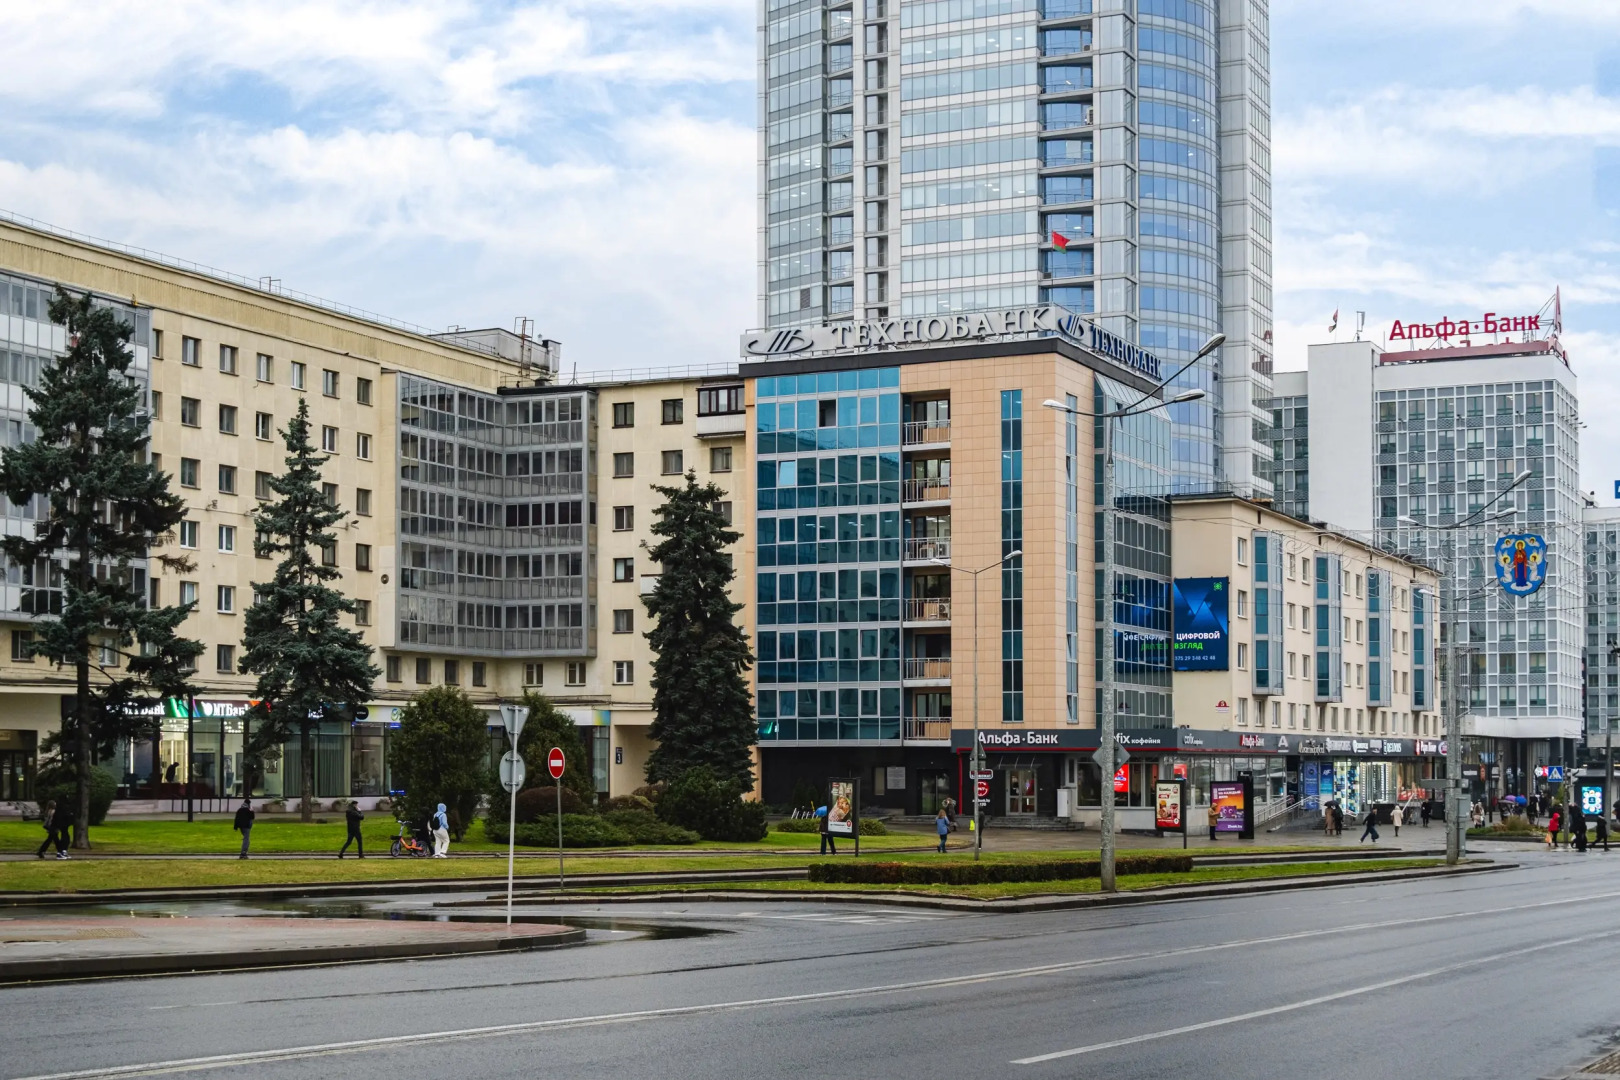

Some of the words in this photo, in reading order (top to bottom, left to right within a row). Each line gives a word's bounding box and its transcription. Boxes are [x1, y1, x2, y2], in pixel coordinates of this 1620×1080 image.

[831, 308, 1050, 349] ТЕХНОБАНК
[1090, 324, 1163, 381] ТЕХНОБАНК
[1176, 631, 1221, 641] ЦИФРОВОЙ
[1174, 642, 1204, 650] ВЗГЛЯД
[1131, 737, 1161, 745] кофейня
